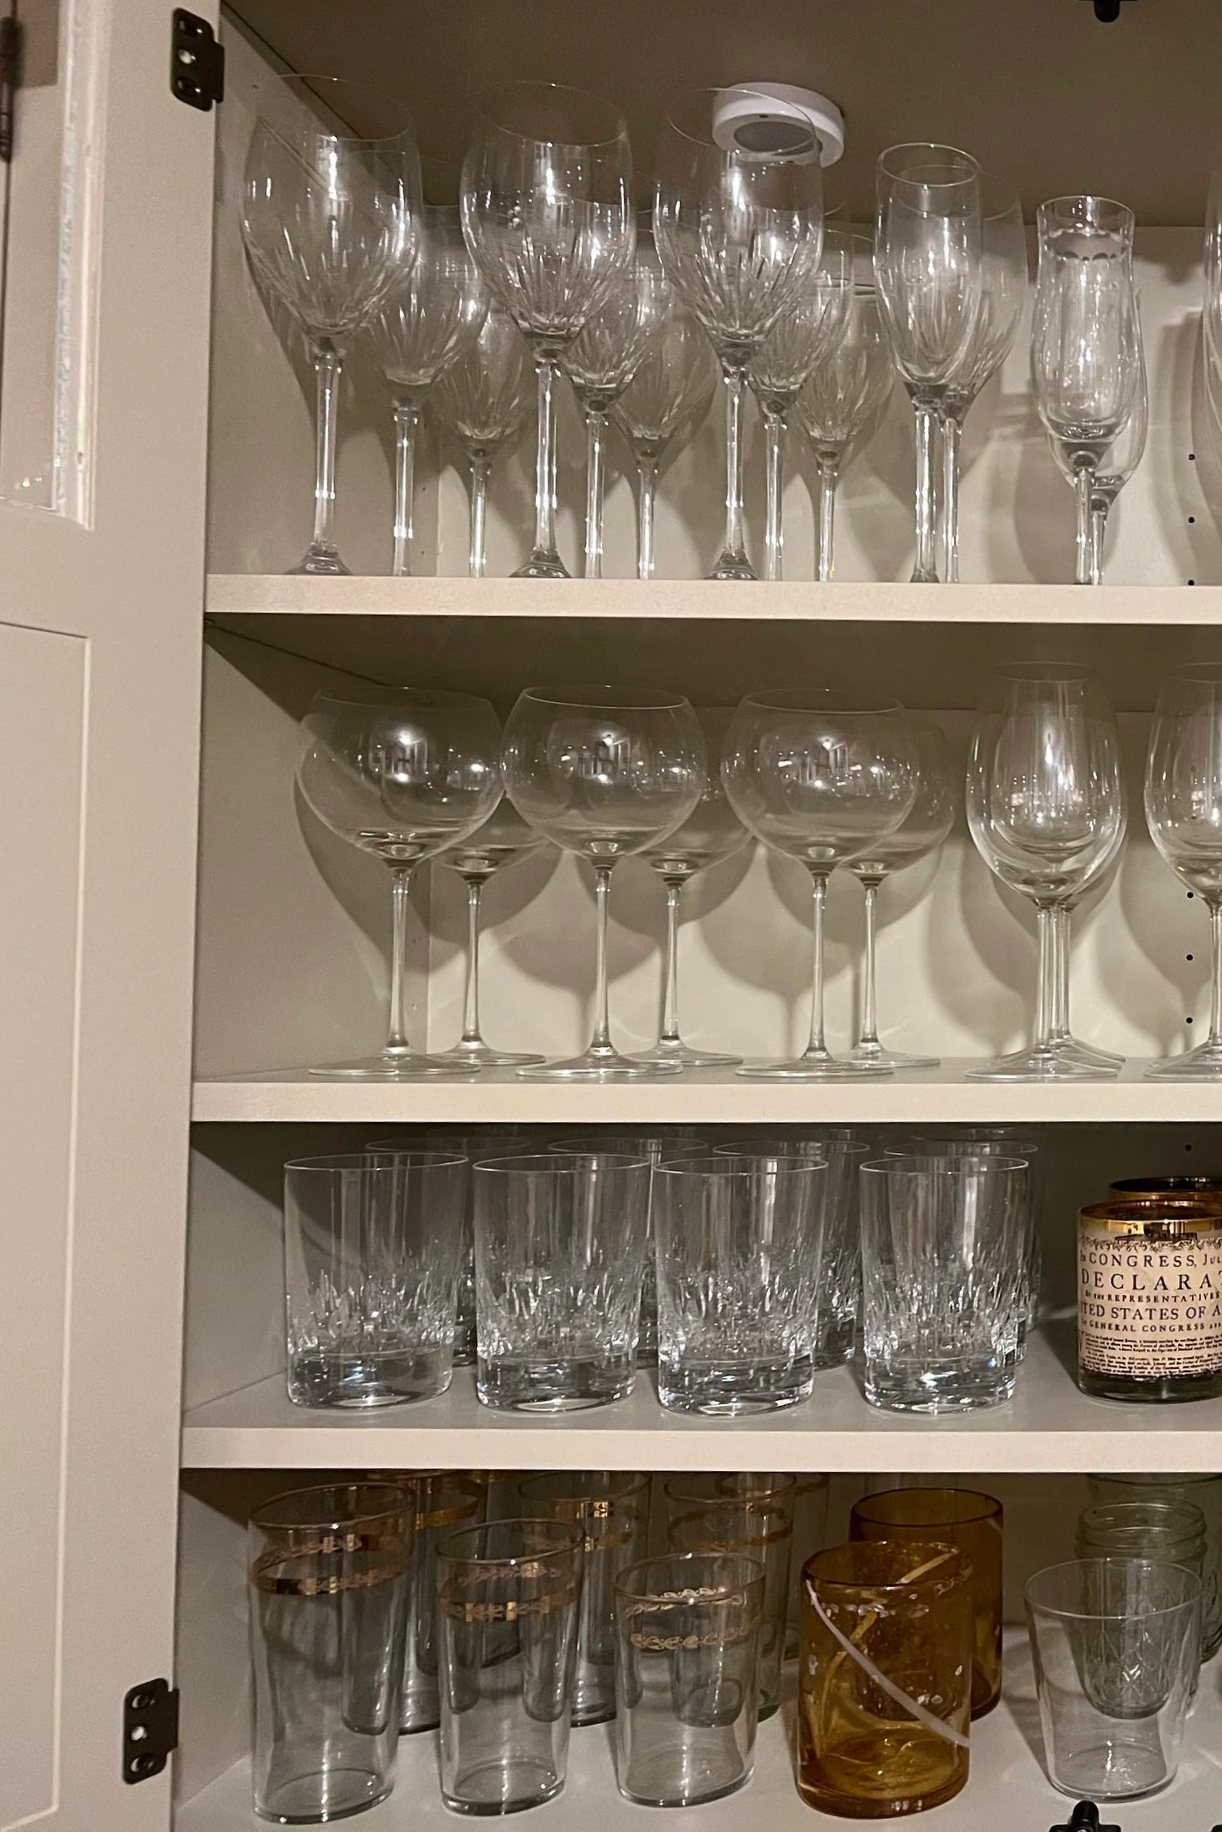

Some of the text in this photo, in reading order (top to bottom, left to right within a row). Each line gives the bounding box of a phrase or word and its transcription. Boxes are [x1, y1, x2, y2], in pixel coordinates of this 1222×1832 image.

[1089, 1252, 1197, 1268] CONGRESS,
[1107, 1291, 1221, 1303] REPRESENTATIVES
[1111, 1306, 1179, 1320] STATES
[1186, 1305, 1206, 1319] OF
[1089, 1320, 1136, 1332] GENERAL
[1141, 1323, 1205, 1332] CONGRESS
